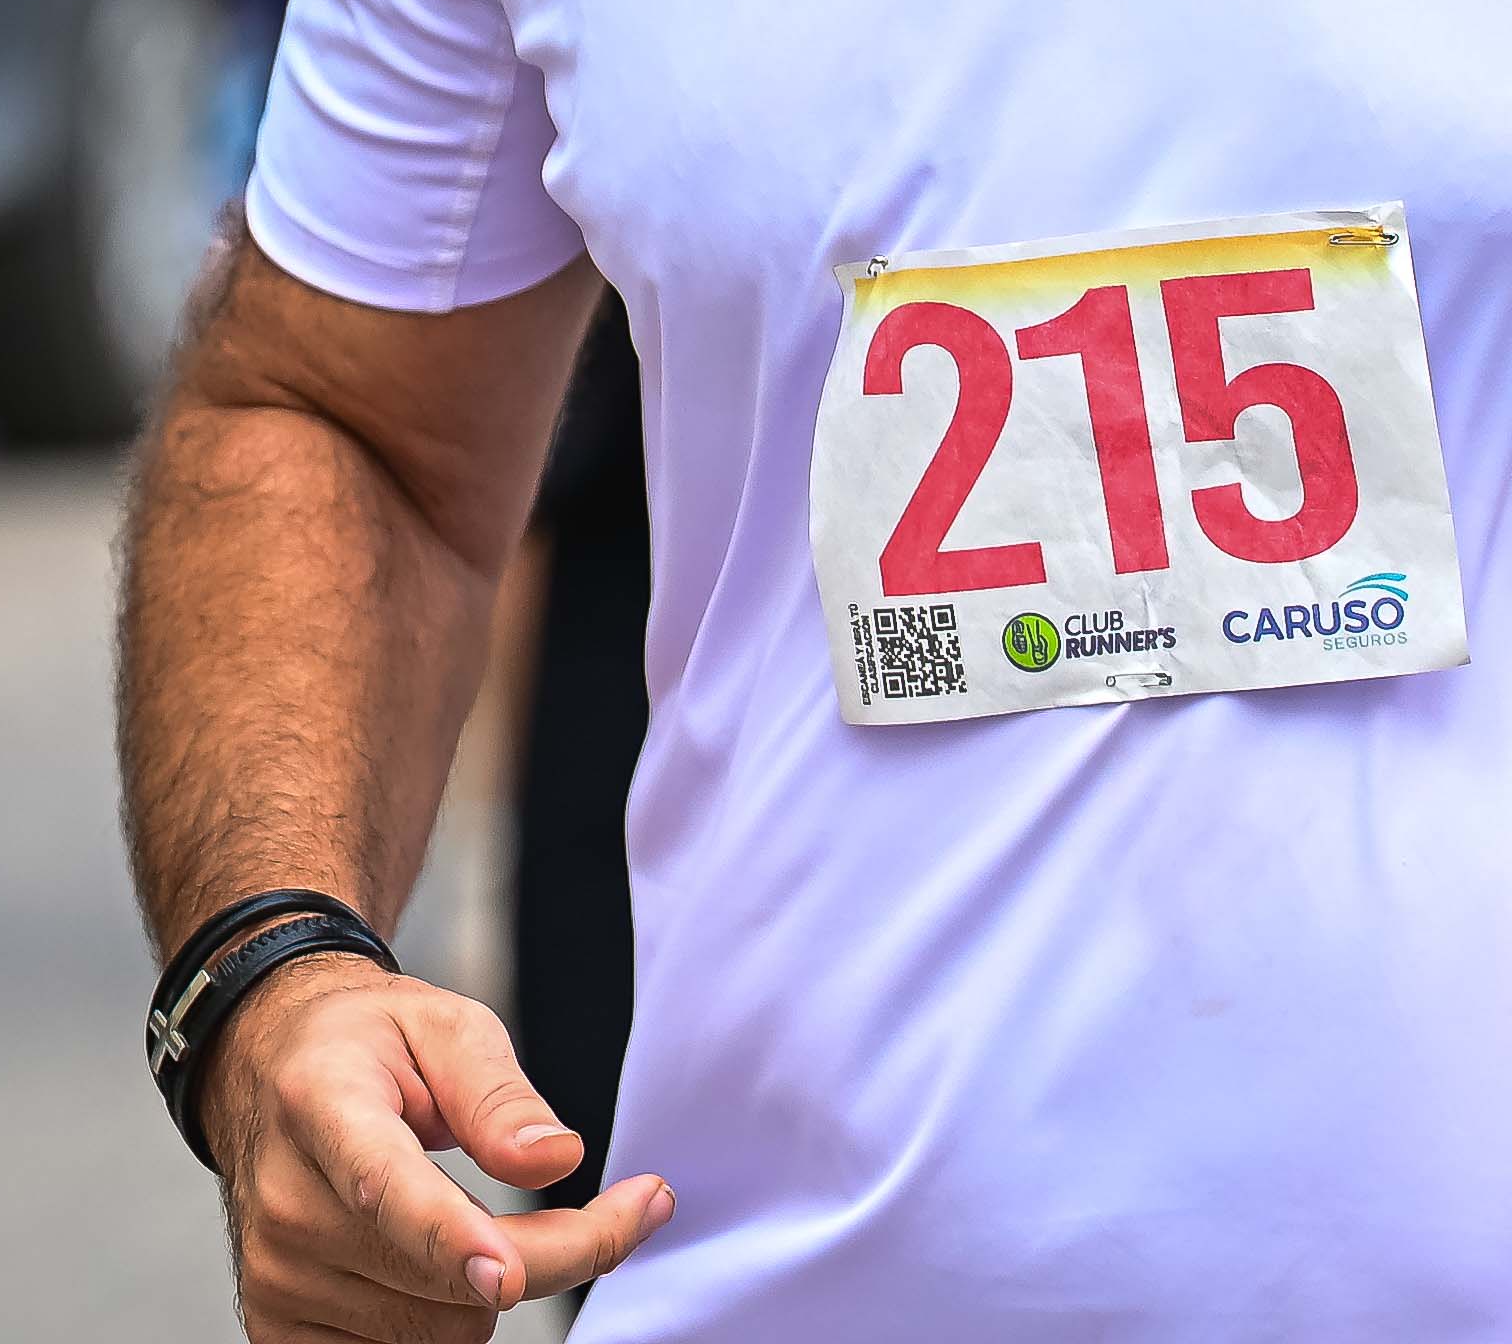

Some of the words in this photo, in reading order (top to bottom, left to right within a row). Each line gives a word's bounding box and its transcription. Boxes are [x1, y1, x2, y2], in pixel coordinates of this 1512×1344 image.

[863, 268, 1358, 597] 215
[1064, 611, 1123, 636] CLUB
[1222, 597, 1404, 643] CARUSO
[1065, 627, 1177, 659] RUNNER'S
[1323, 631, 1408, 651] SEGUROS
